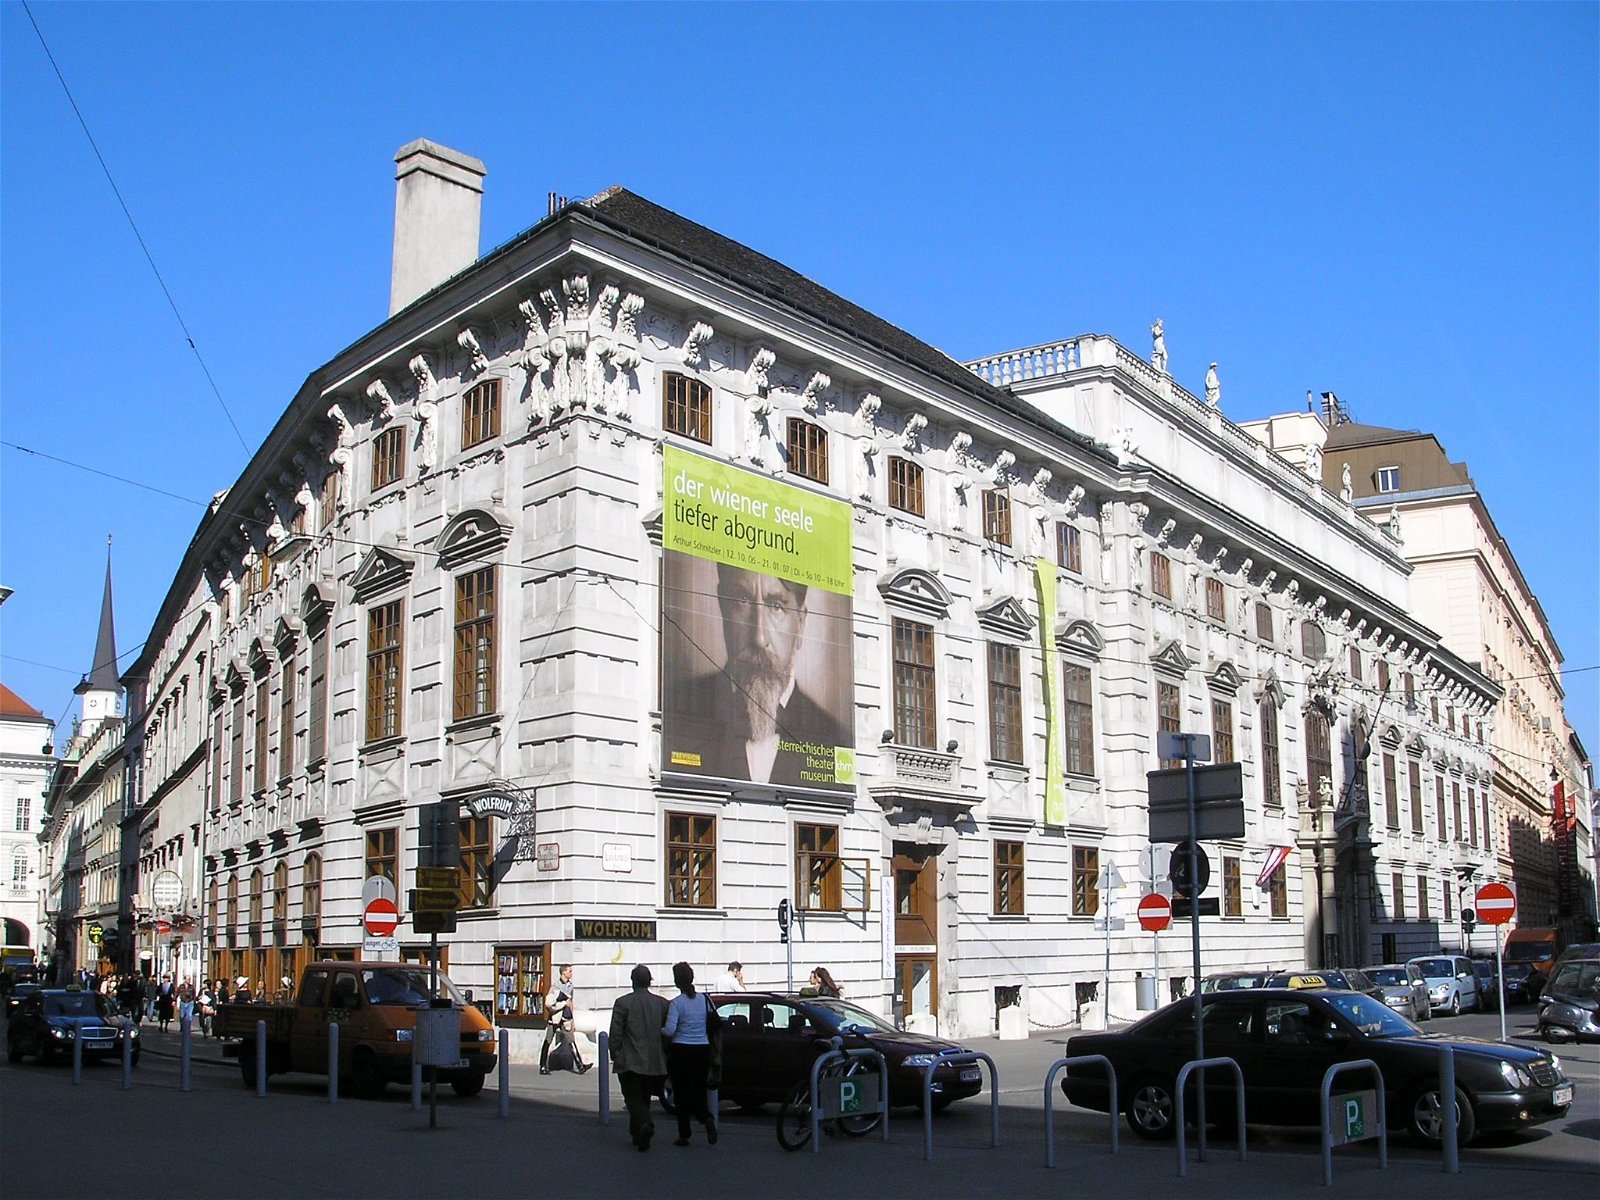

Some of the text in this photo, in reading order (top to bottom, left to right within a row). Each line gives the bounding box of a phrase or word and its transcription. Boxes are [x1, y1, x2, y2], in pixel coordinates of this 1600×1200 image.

[673, 469, 814, 533] der wiener seele
[674, 499, 800, 556] tiefer abgrund.
[673, 534, 692, 547] Arthur
[693, 540, 722, 555] Schnitzler
[834, 578, 845, 588] Uhr
[800, 770, 834, 783] museum
[806, 756, 834, 770] theater
[473, 798, 512, 812] WOLFRUM
[580, 921, 652, 938] WOLFRUM
[840, 1081, 856, 1112] P
[1346, 1100, 1359, 1136] P
